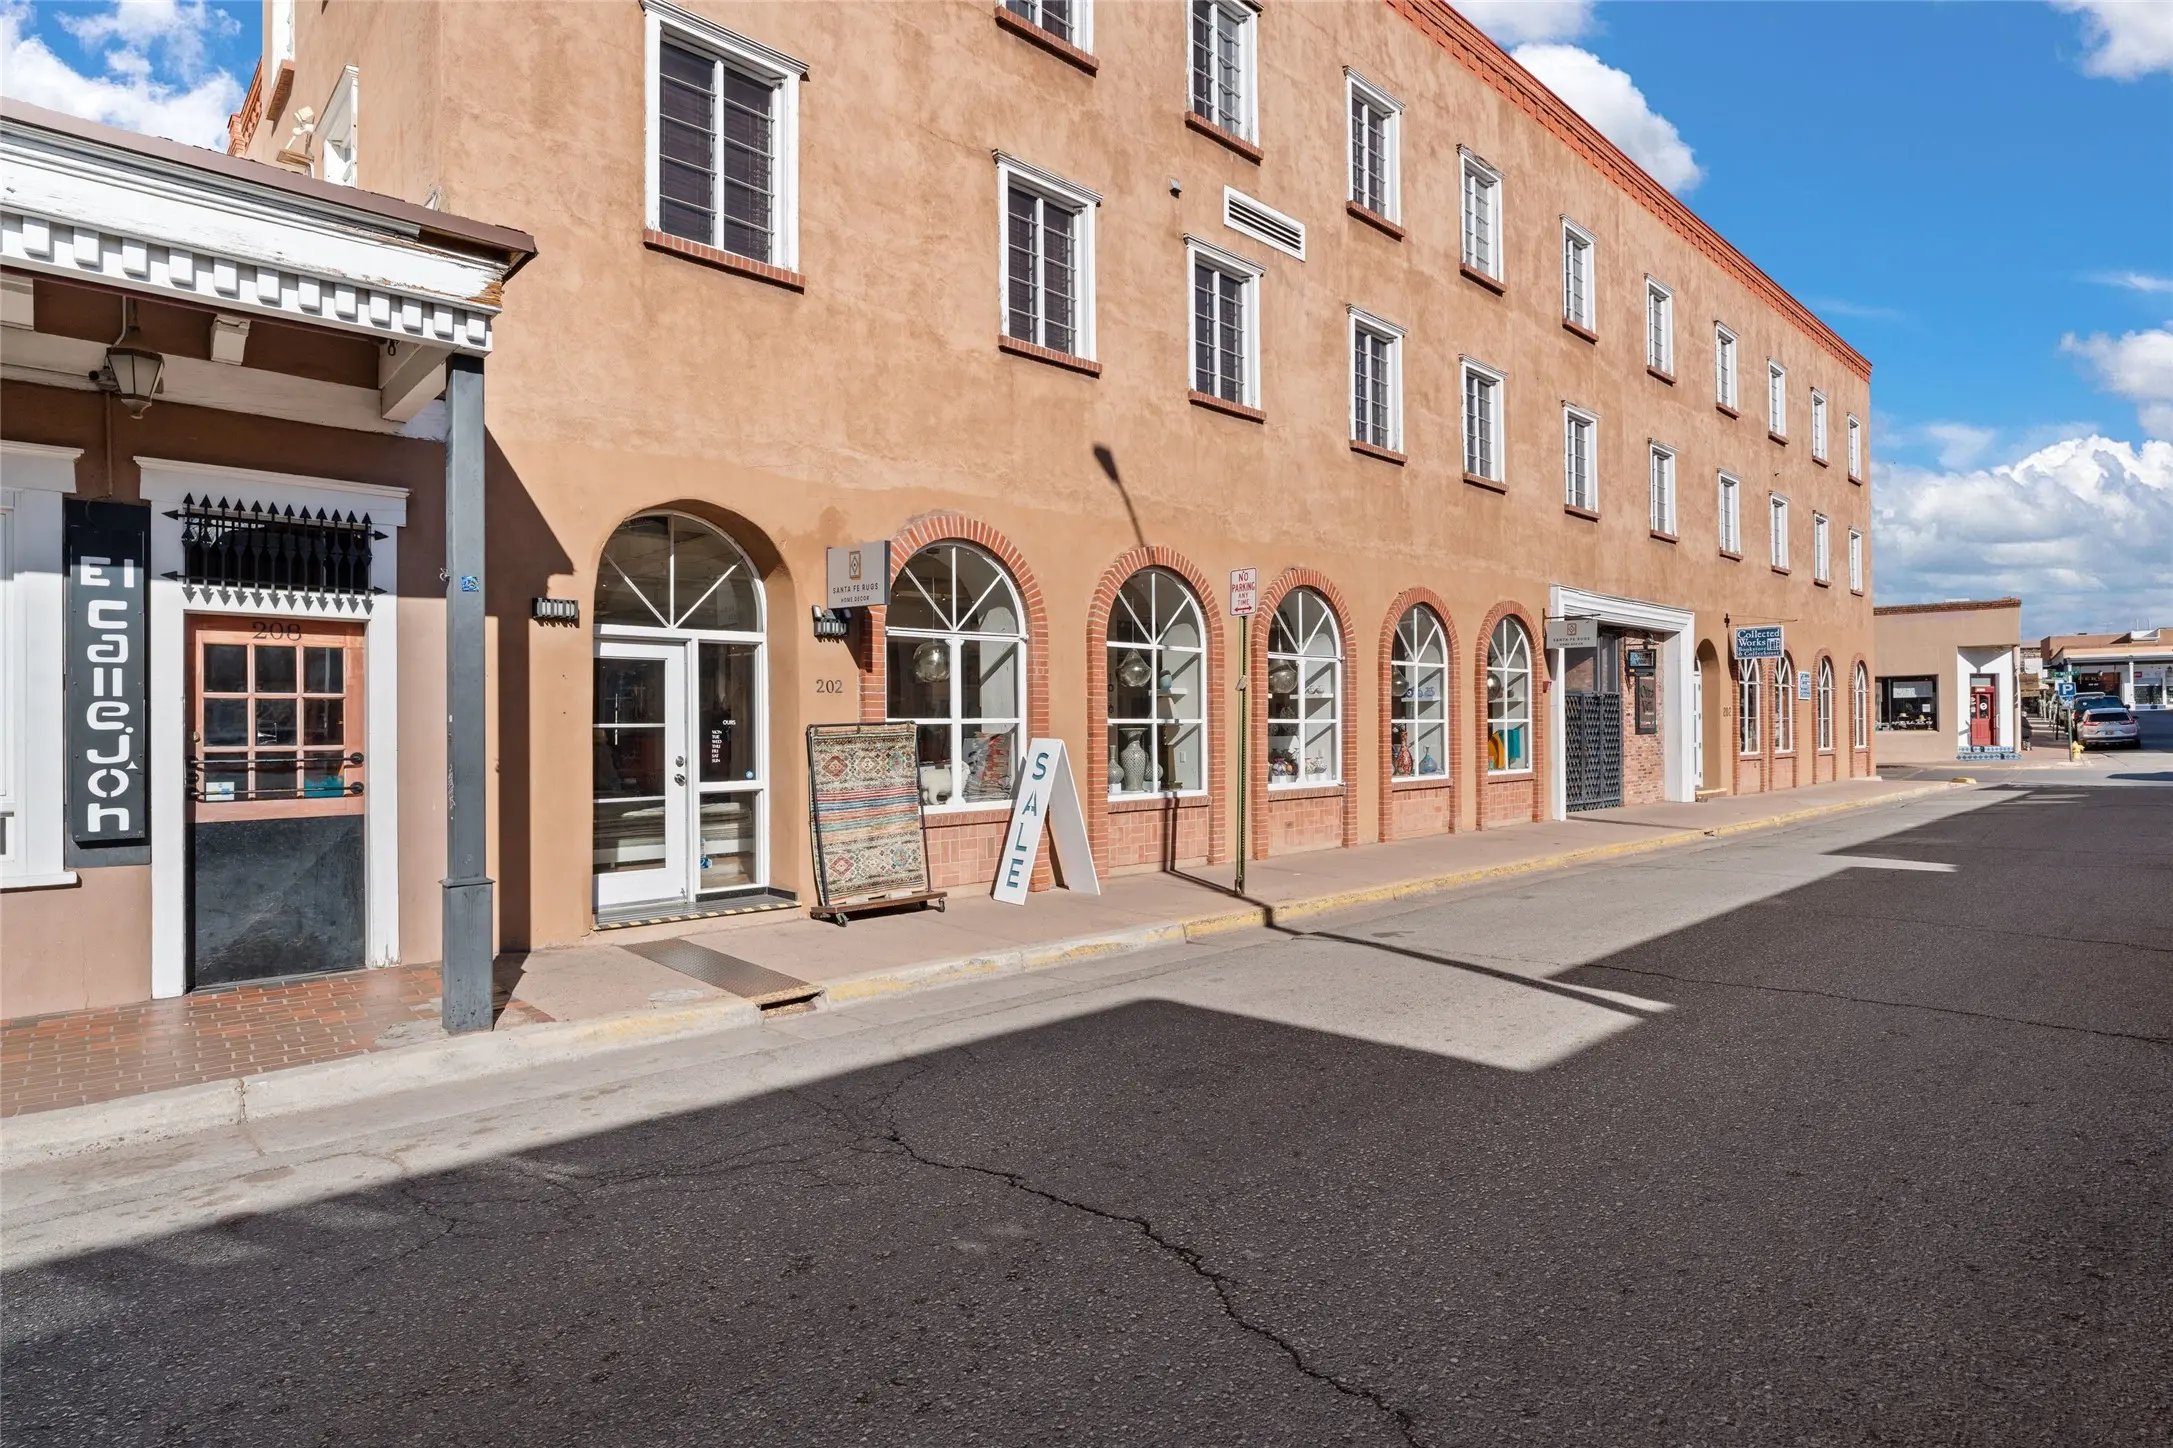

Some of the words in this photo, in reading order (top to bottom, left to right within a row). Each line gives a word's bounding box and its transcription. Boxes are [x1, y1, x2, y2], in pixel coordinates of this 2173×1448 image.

[80, 556, 135, 588] El
[1238, 572, 1249, 582] NO
[832, 585, 852, 595] SANTA
[852, 584, 861, 592] FE
[861, 582, 879, 591] RUGS
[1231, 582, 1256, 593] PARKING
[251, 621, 302, 641] 208
[1737, 629, 1780, 638] Collected
[1738, 638, 1767, 647] Works
[815, 678, 844, 694] 202
[2062, 684, 2074, 695] P
[1006, 752, 1050, 888] SALE
